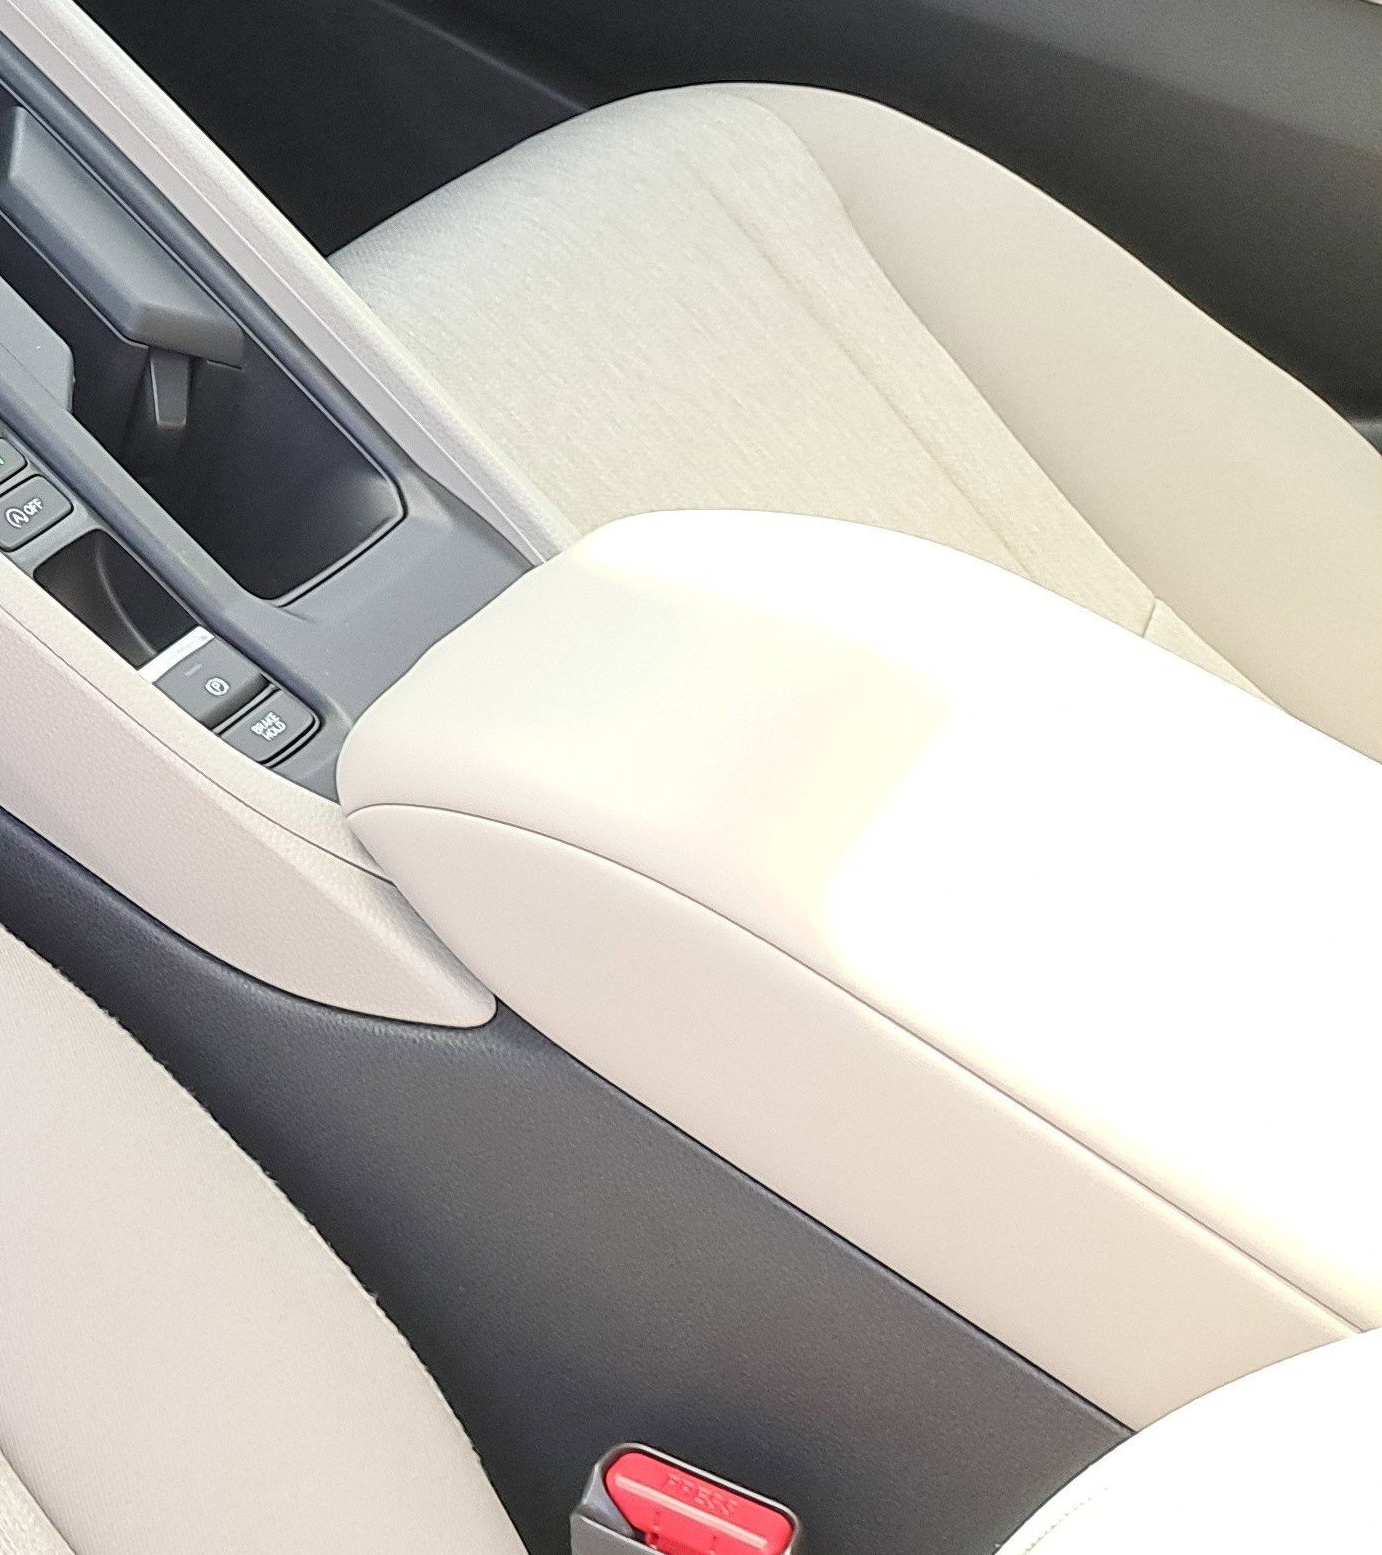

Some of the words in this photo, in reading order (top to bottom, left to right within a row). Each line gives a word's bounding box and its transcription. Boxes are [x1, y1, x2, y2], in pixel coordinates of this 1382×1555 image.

[22, 496, 44, 516] OFF
[250, 711, 280, 735] BRAKE
[261, 719, 287, 742] HOLD
